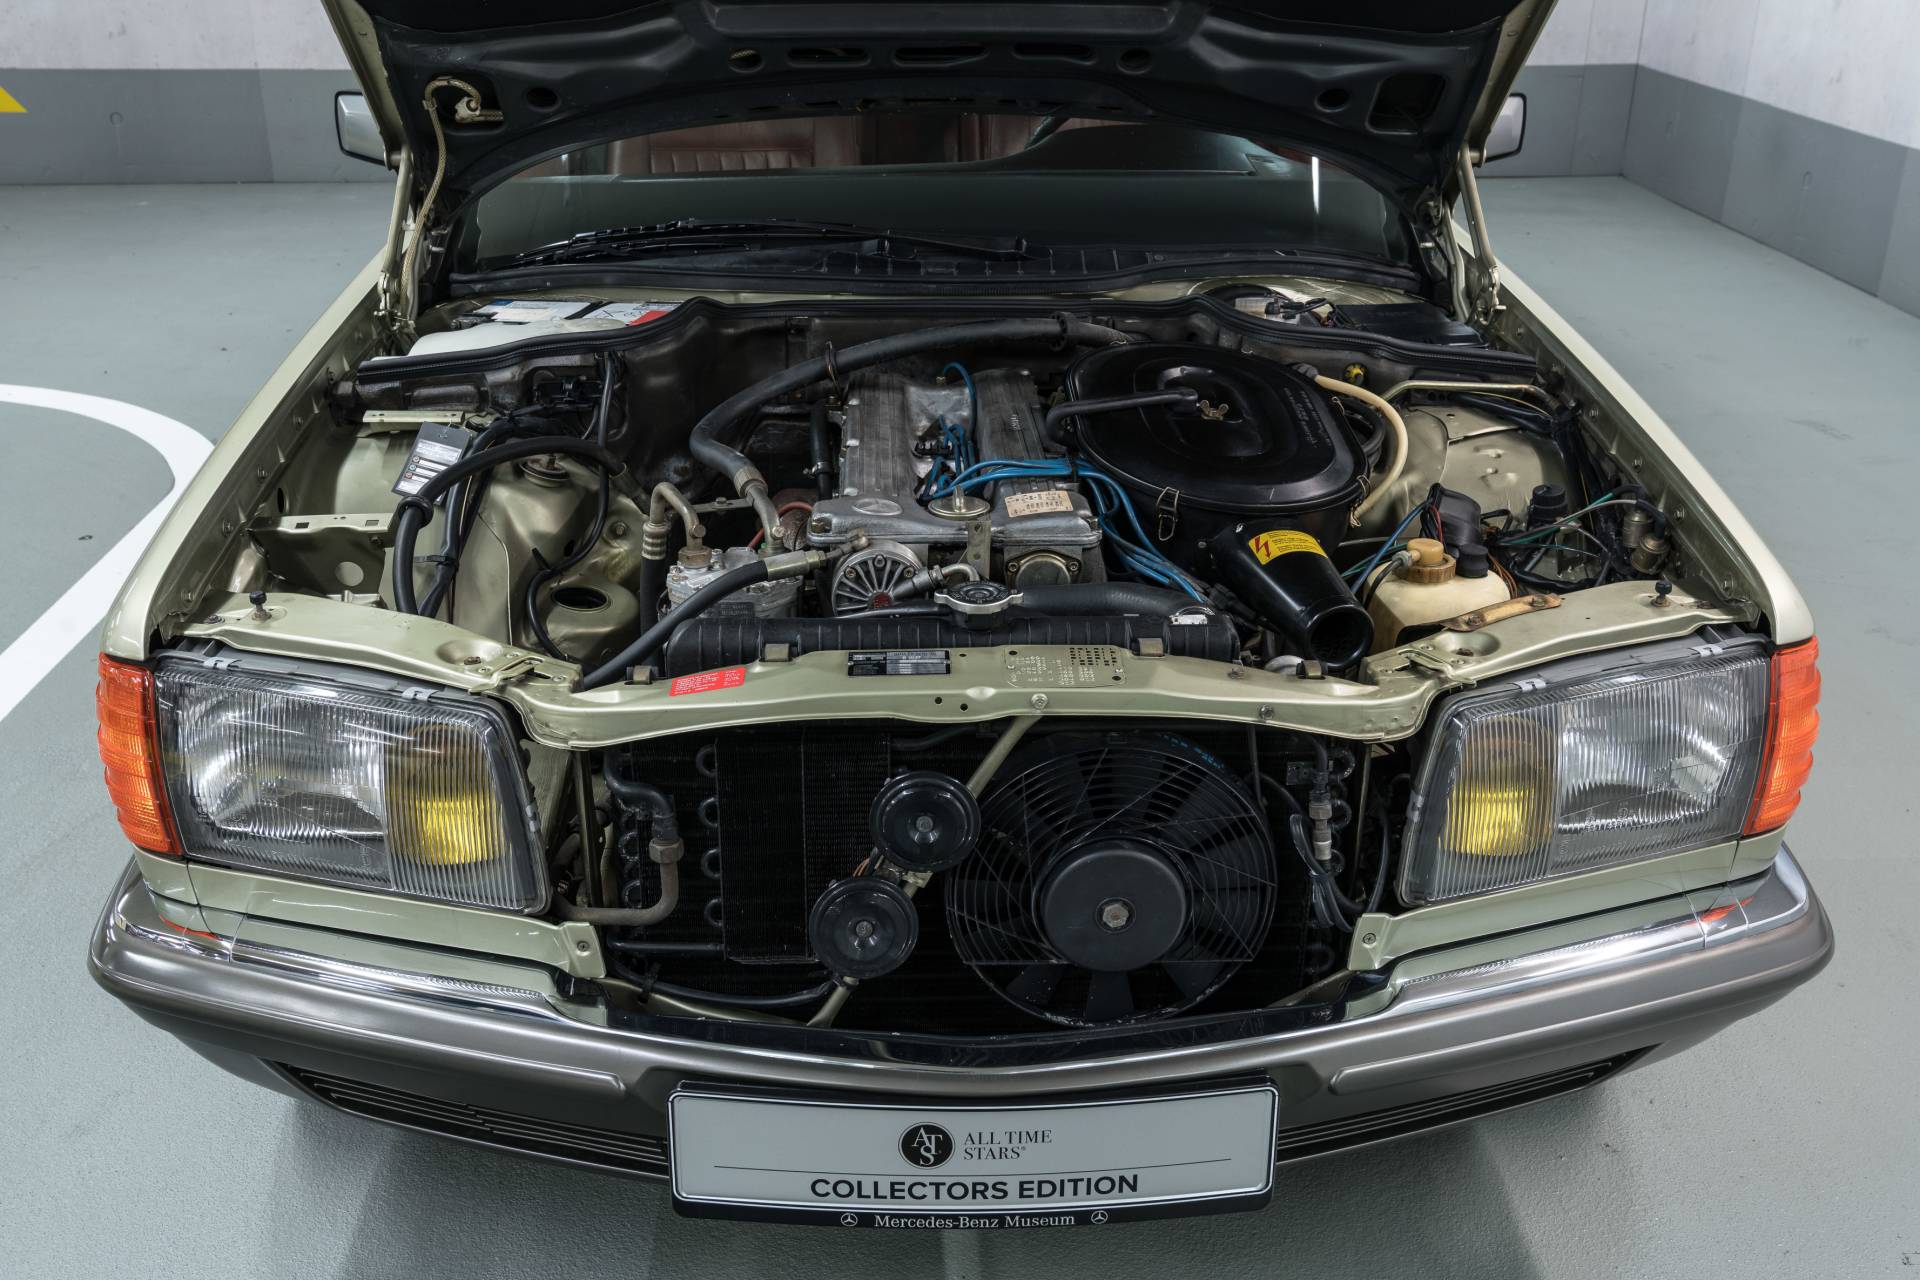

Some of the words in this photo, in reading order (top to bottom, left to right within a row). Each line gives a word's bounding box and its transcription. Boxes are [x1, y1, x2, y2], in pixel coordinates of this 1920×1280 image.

[964, 1131, 1000, 1145] ALL
[1005, 1129, 1052, 1144] TIME
[810, 1178, 1009, 1201] COLLECTORS
[1018, 1174, 1138, 1199] EDITION
[875, 1215, 999, 1229] Mercedes-Benz
[1004, 1214, 1075, 1228] Museum
